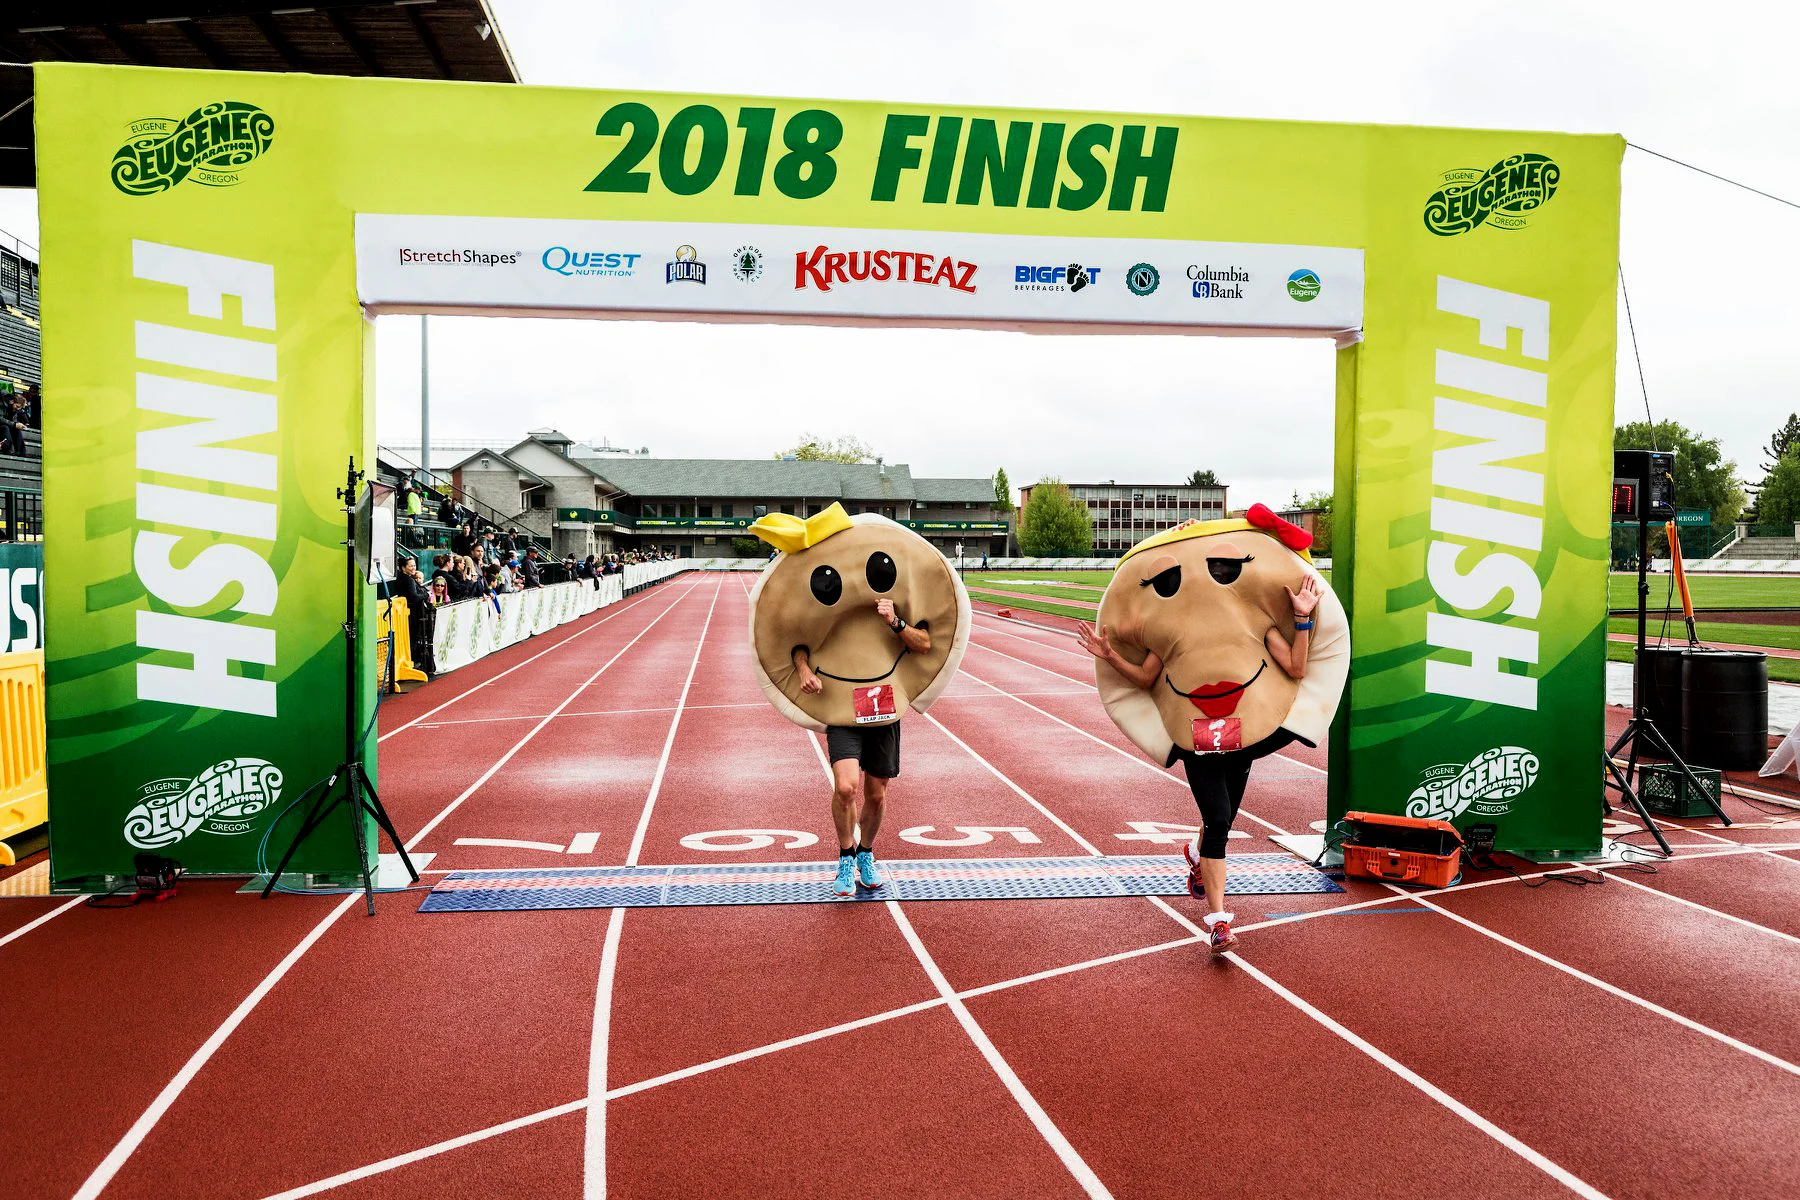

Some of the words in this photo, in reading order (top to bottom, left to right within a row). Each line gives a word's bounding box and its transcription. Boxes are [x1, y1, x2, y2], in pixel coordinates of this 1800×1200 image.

[131, 122, 167, 134] EUGENE
[139, 112, 251, 181] EUGENE
[193, 142, 254, 168] MARATHON
[582, 102, 844, 200] 2018
[870, 113, 1180, 213] FINISH
[199, 172, 239, 183] OREGON
[1444, 172, 1475, 182] EUGENE
[1446, 163, 1543, 223] EUGENE
[1490, 189, 1542, 212] MARATHON
[1494, 217, 1527, 226] OREGON
[541, 246, 642, 276] QUEST
[733, 245, 763, 259] OREGON
[575, 269, 632, 277] NUTRITION
[668, 263, 705, 282] POLAR
[794, 244, 978, 293] KRUSTEAZ
[1186, 264, 1250, 282] Columbia
[1210, 282, 1243, 299] Bank
[1289, 288, 1318, 298] Eugene
[132, 238, 279, 718] FINISH
[1425, 275, 1550, 711] FINISH
[1213, 731, 1221, 747] 2
[1425, 767, 1455, 778] EUGENE
[144, 781, 180, 794] EUGENE
[1429, 754, 1522, 816] EUGENE
[1472, 778, 1522, 802] MARATHON
[151, 766, 261, 836] EUGENE
[205, 793, 264, 820] MARATHON
[1476, 804, 1509, 813] OREGON
[210, 822, 250, 832] OREGON
[898, 825, 1043, 847] 5
[452, 831, 601, 854] 7
